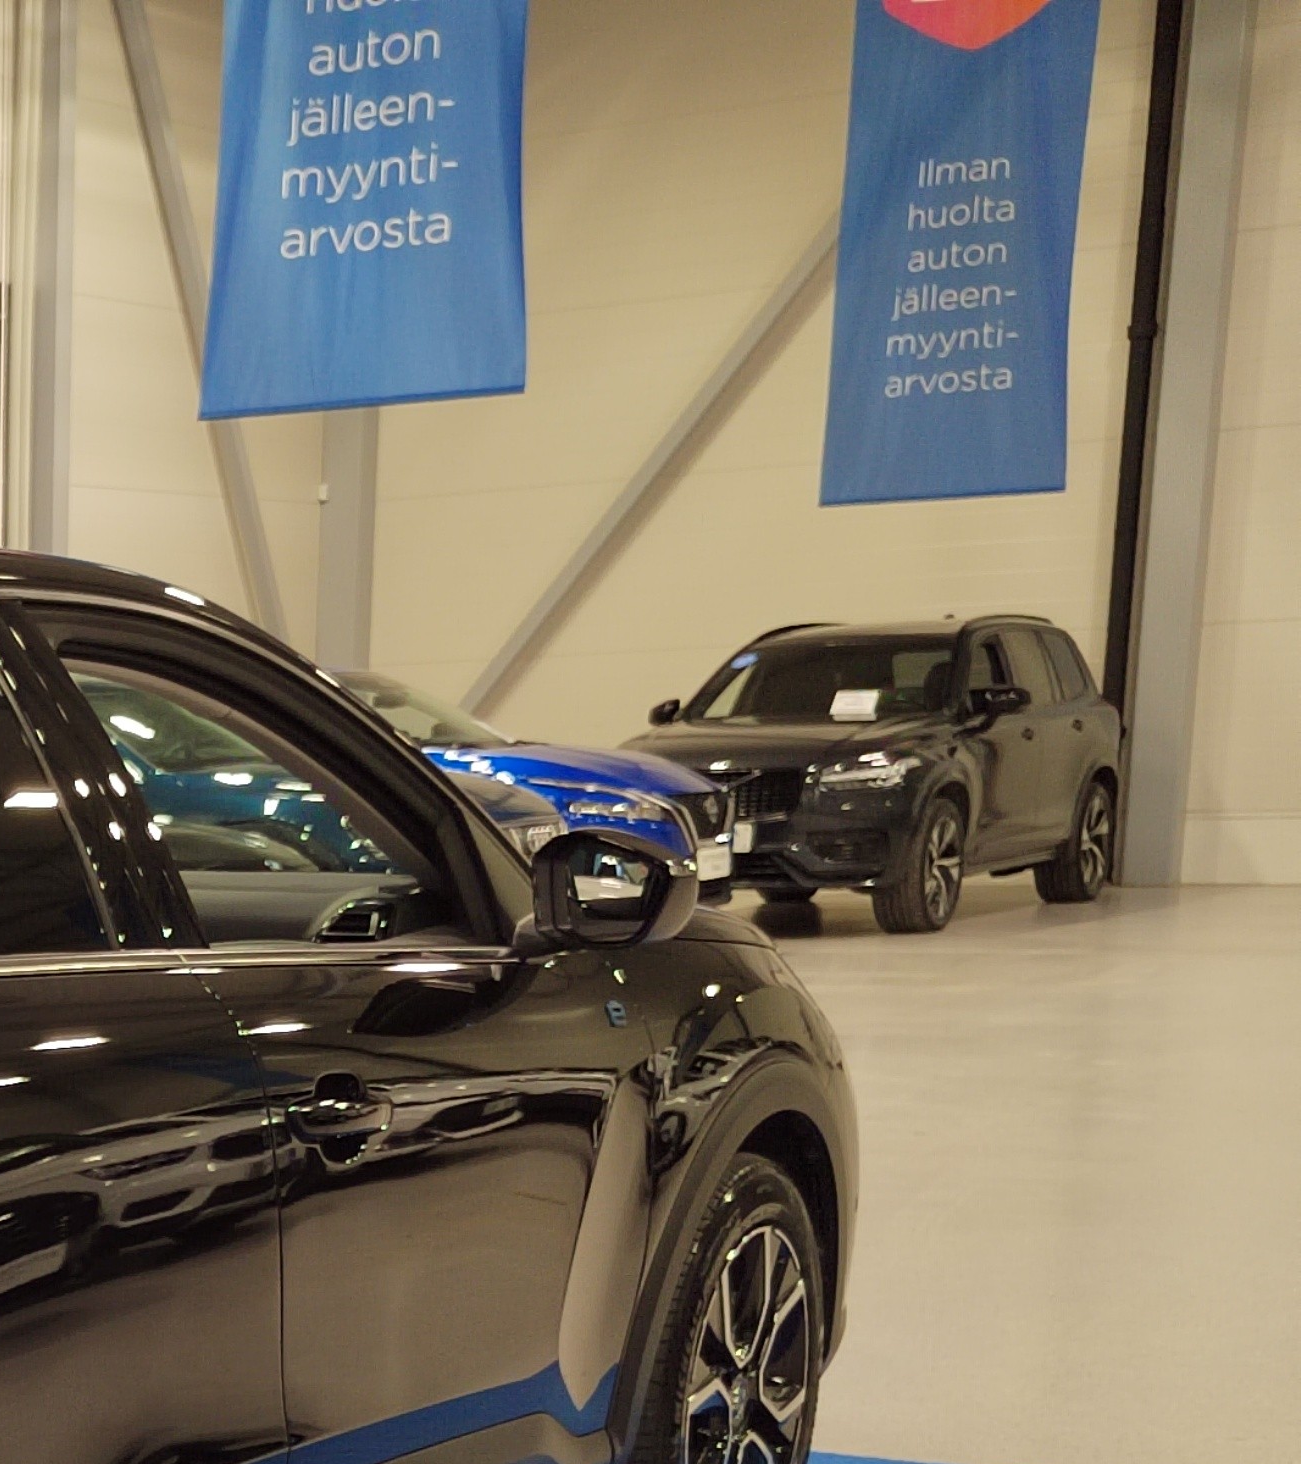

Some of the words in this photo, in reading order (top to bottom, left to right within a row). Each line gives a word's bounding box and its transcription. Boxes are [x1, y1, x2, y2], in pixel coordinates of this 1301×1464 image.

[308, 27, 441, 77] auton
[287, 91, 455, 147] jälleen-
[281, 142, 460, 203] myynti-
[917, 155, 1012, 187] Ilman
[907, 194, 1016, 231] huolta
[279, 208, 452, 260] arvosta
[906, 238, 1008, 273] auton
[893, 283, 1017, 322] jälleen-
[886, 321, 1019, 360] myynti-
[884, 363, 1013, 399] arvosta
